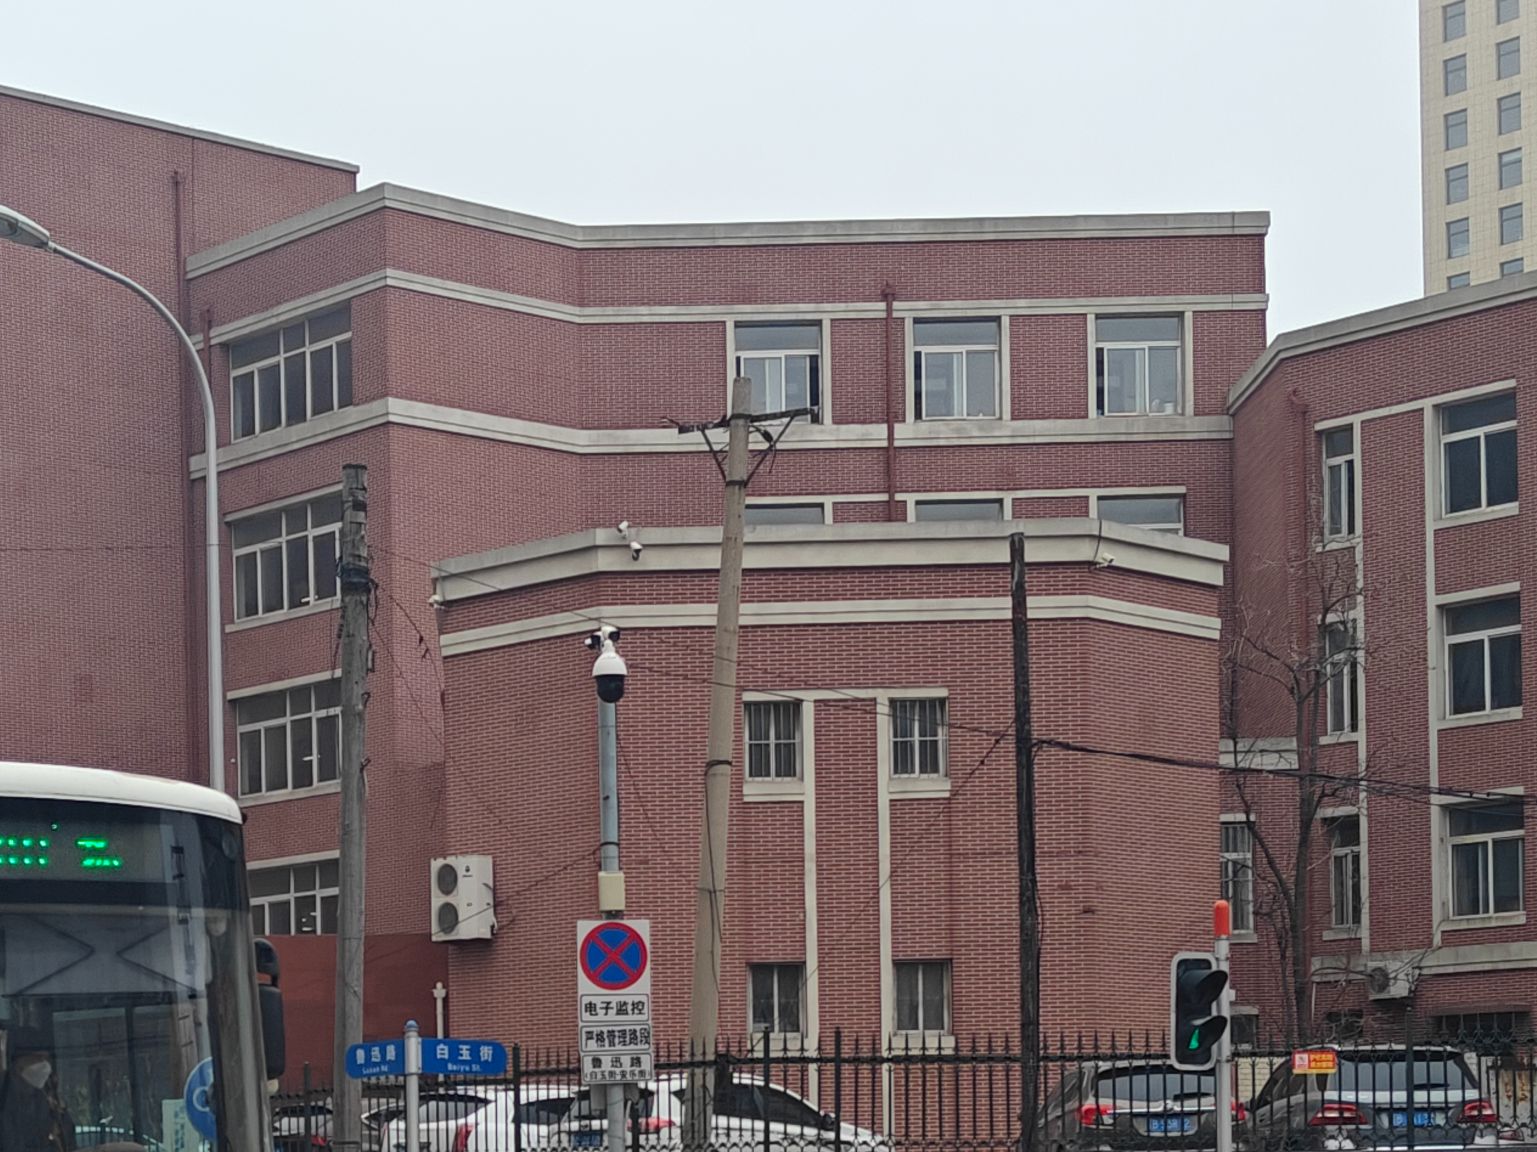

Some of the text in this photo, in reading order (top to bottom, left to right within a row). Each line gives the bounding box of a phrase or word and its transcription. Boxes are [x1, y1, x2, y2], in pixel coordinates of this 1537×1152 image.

[584, 1000, 646, 1016] 电子监控
[584, 1027, 651, 1048] 严格管理路段
[356, 1044, 397, 1065] 鲁迅路
[436, 1043, 493, 1062] 白玉街
[591, 1056, 642, 1069] 鲁迅路
